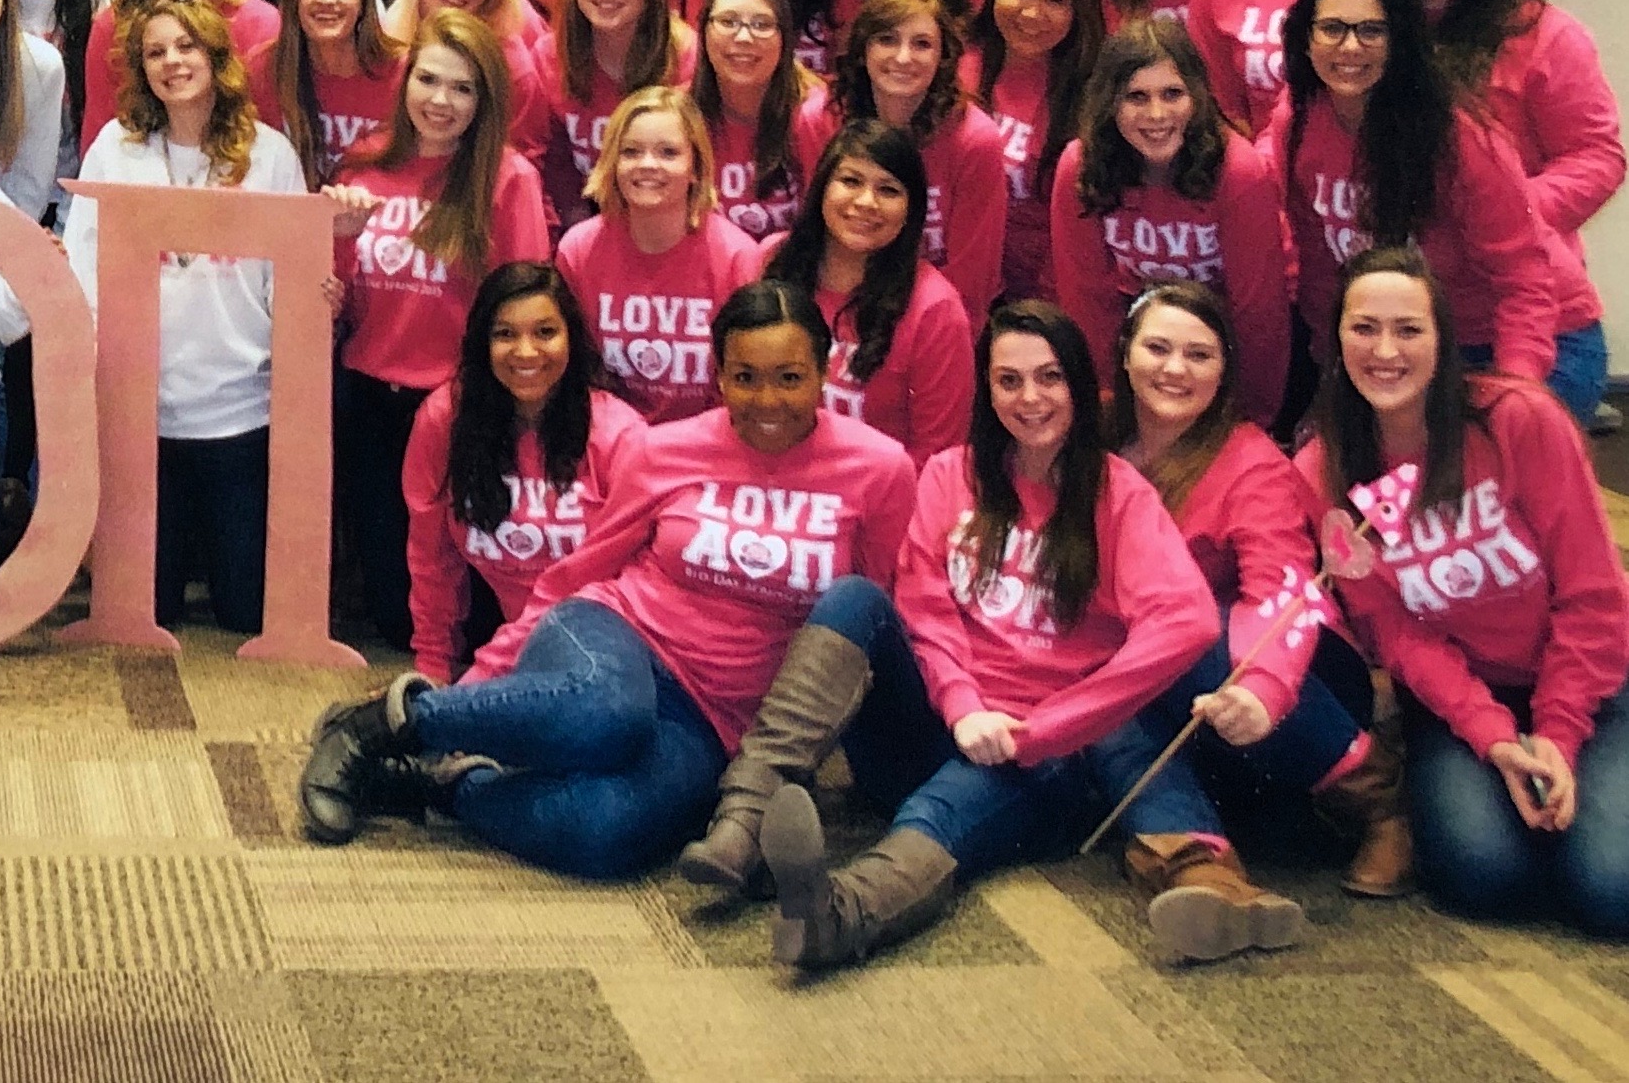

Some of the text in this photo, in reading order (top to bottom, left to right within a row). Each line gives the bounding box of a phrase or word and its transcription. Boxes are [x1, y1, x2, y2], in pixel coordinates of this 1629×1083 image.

[1104, 217, 1220, 256] LOVE
[598, 292, 713, 336] LOVE
[696, 481, 842, 535] LOVE
